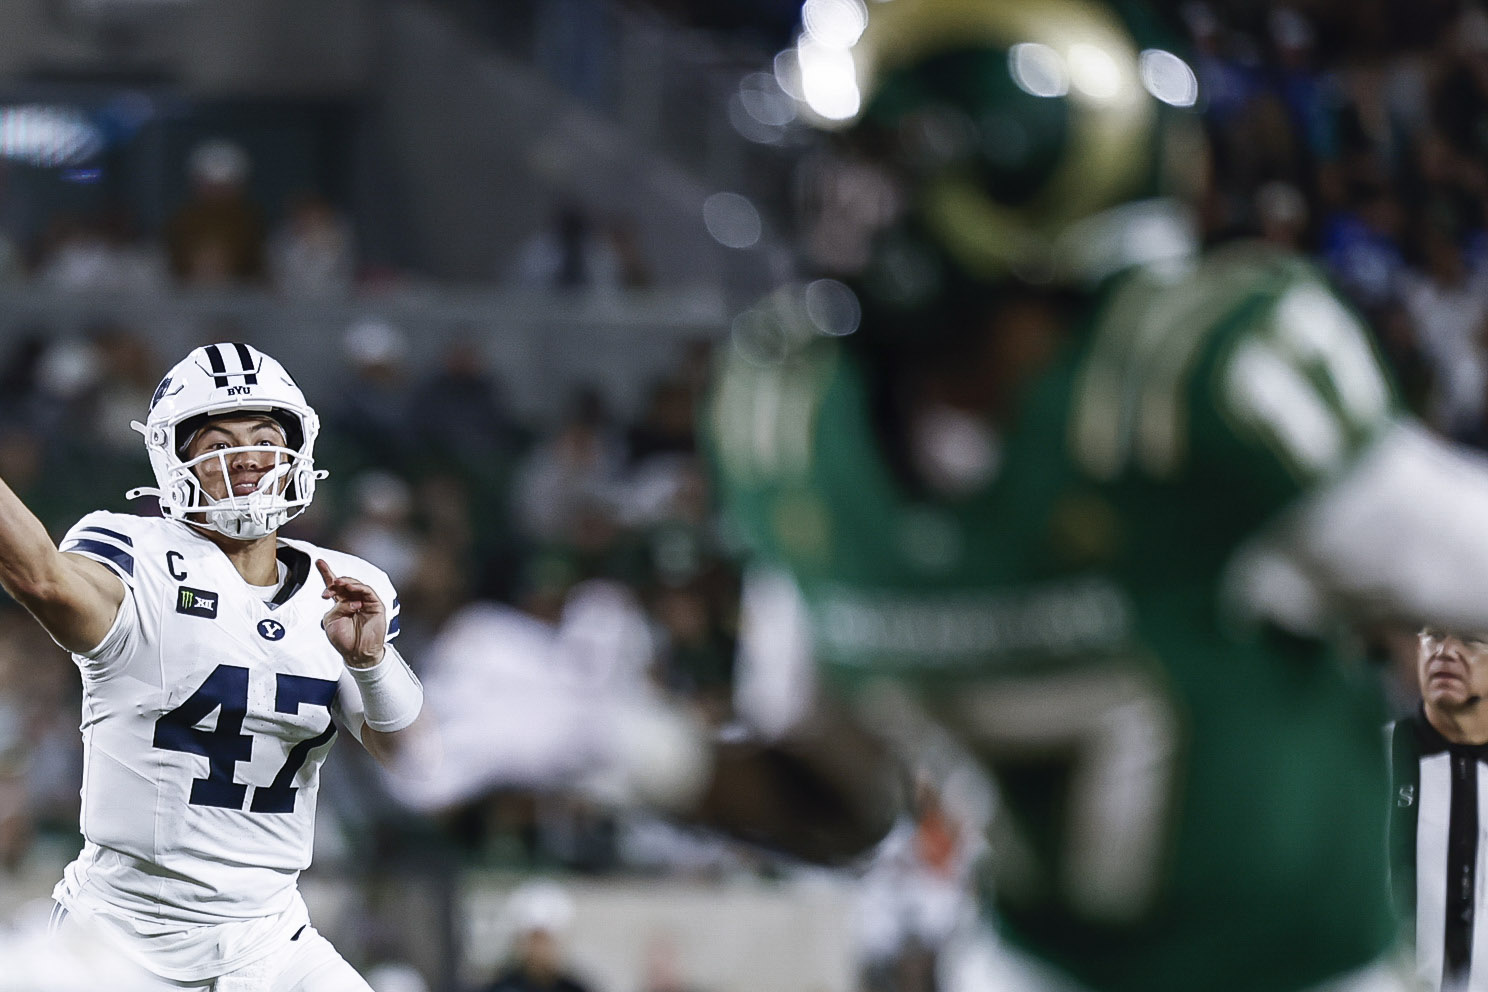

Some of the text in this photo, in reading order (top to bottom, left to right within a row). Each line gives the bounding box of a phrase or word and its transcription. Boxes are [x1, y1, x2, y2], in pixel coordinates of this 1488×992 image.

[227, 385, 251, 396] BYU
[166, 550, 188, 581] C
[261, 621, 282, 638] Y
[153, 664, 339, 814] 47
